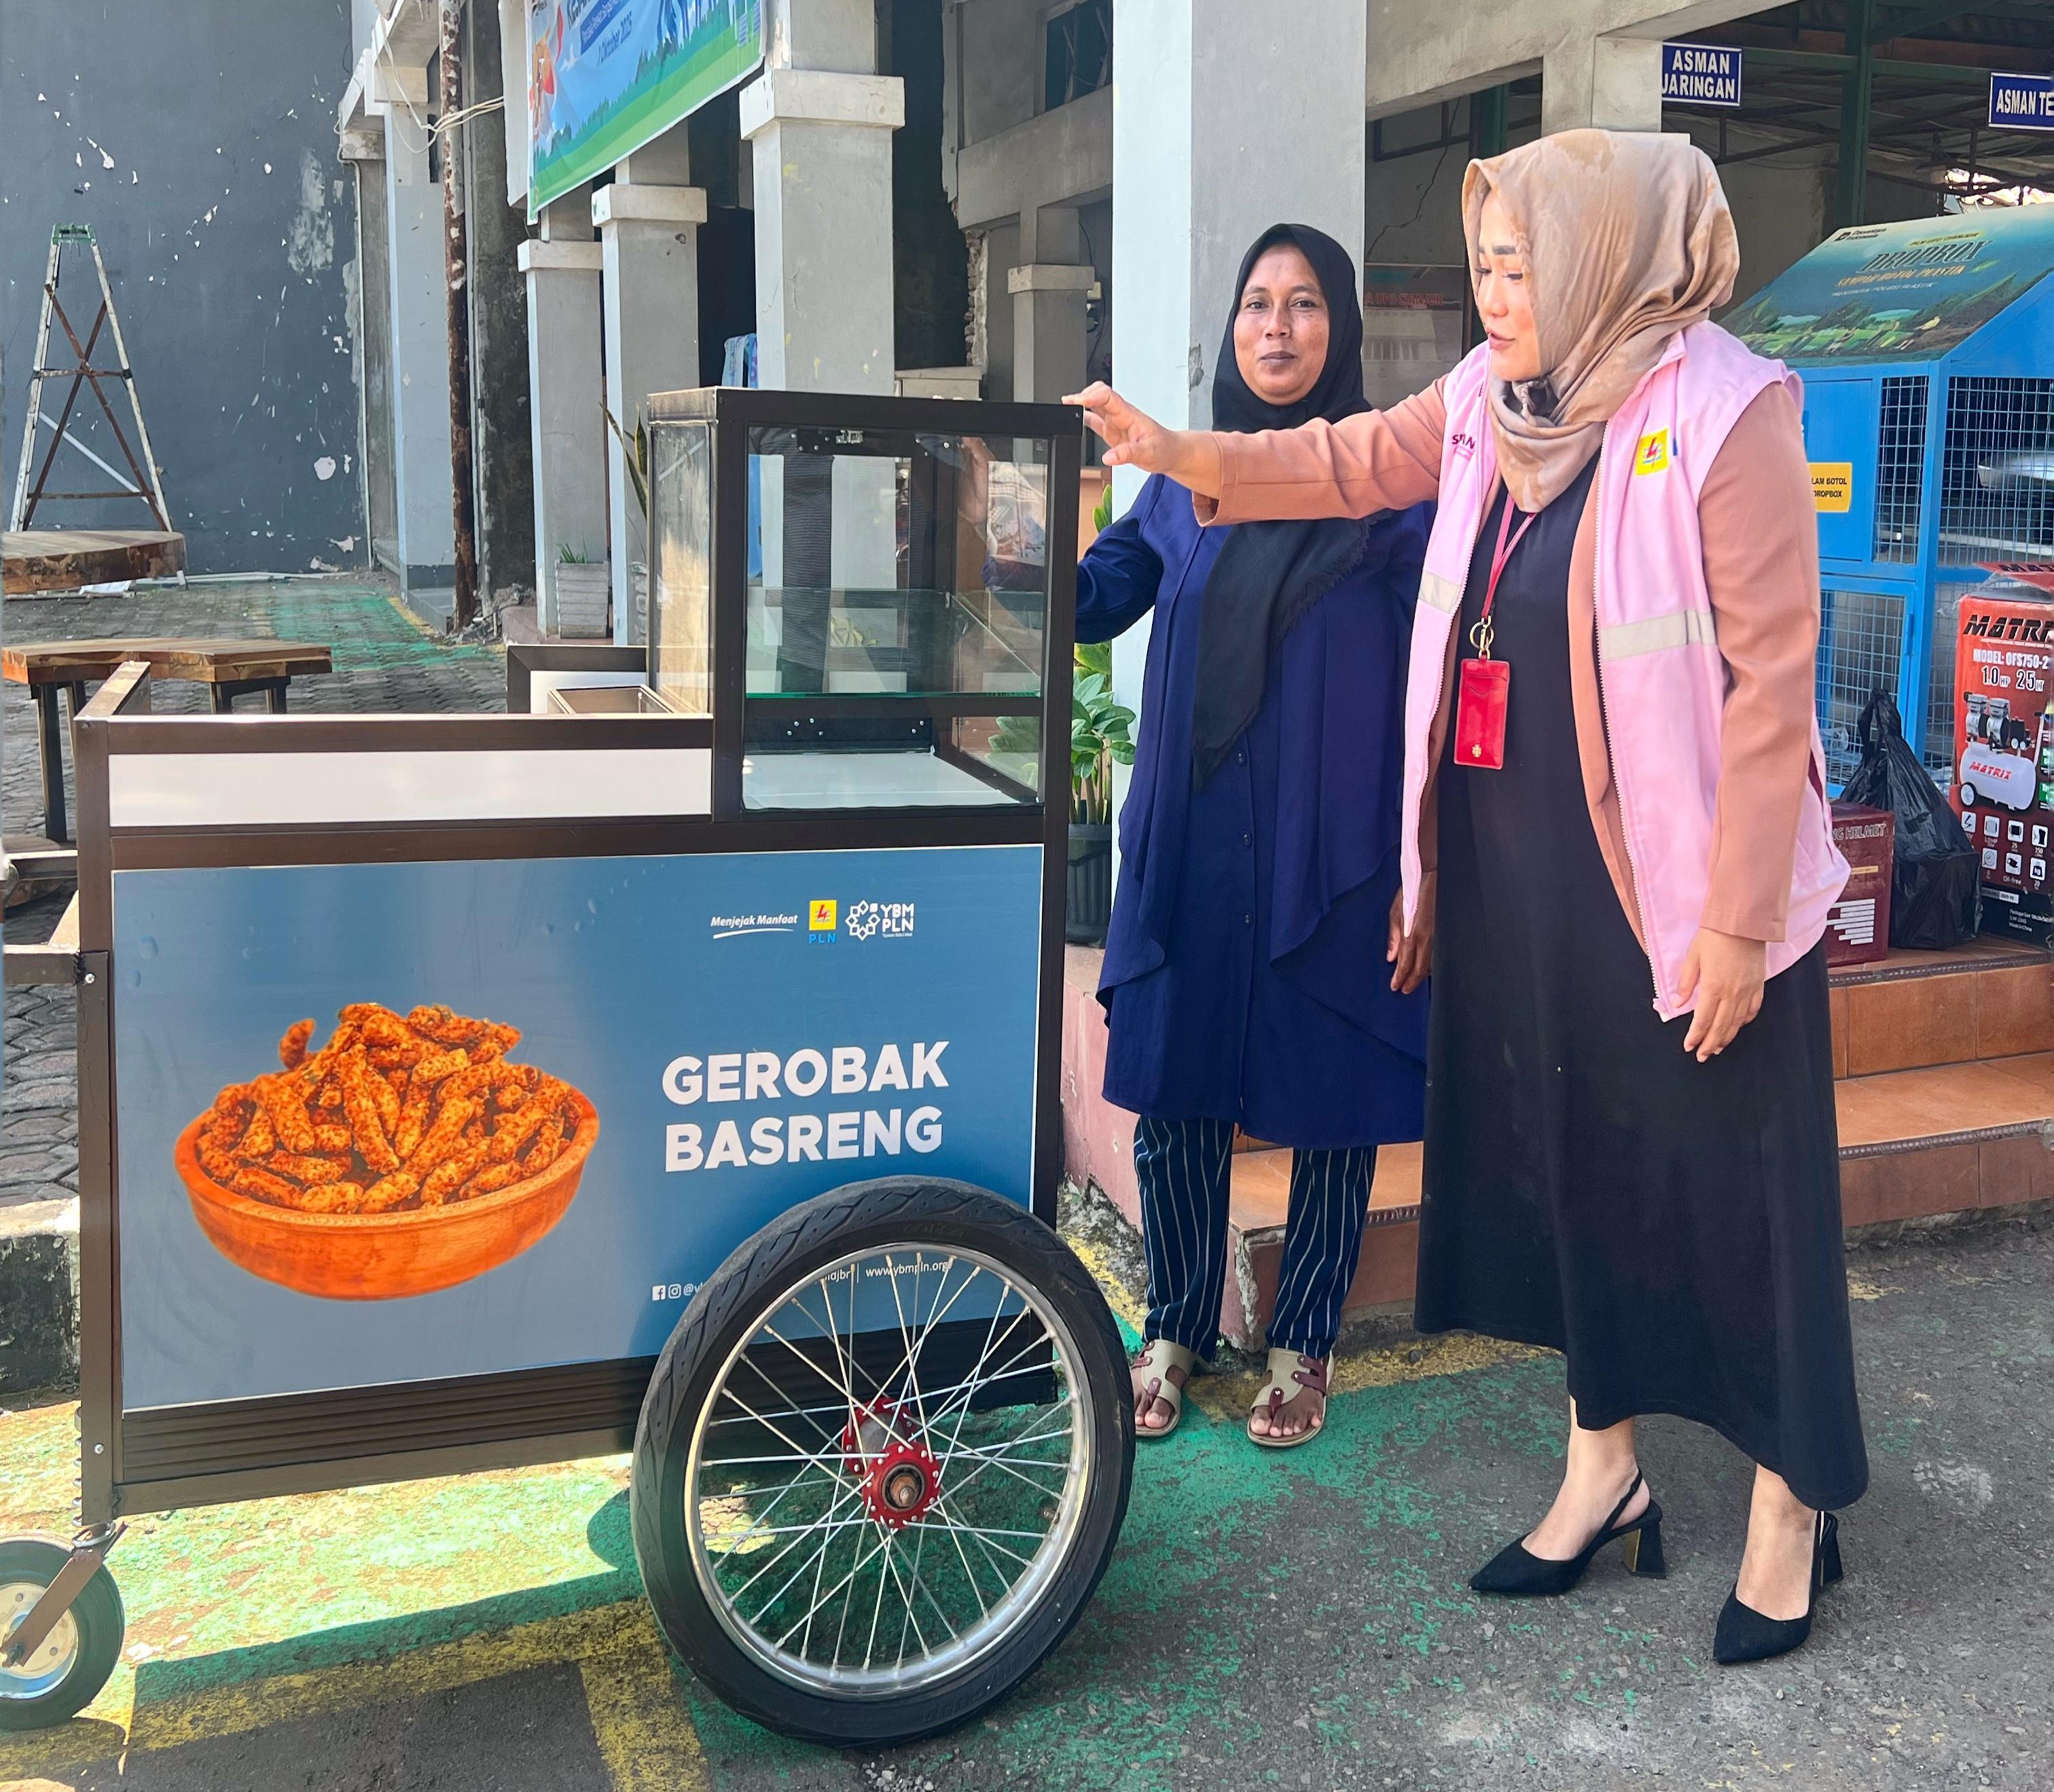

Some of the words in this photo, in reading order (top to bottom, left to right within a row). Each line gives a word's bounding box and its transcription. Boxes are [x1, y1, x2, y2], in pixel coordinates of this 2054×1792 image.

[1672, 50, 1729, 74] ASMAN
[1662, 73, 1735, 99] JARINGAN
[1996, 89, 2036, 115] ASMAN
[1857, 240, 1993, 273] DROPBOX
[1972, 648, 2004, 665] MODEL:
[1969, 761, 2012, 781] MATRIX
[1845, 823, 1886, 840] HELMET
[2003, 875, 2021, 885] Oil-free
[880, 903, 914, 918] YBM
[710, 914, 755, 929] Menjejak
[757, 914, 798, 925] Manfaat
[882, 917, 914, 933] PLN
[809, 933, 837, 944] PLN
[662, 1041, 950, 1105] GEROBAK
[666, 1105, 943, 1172] BASRENG
